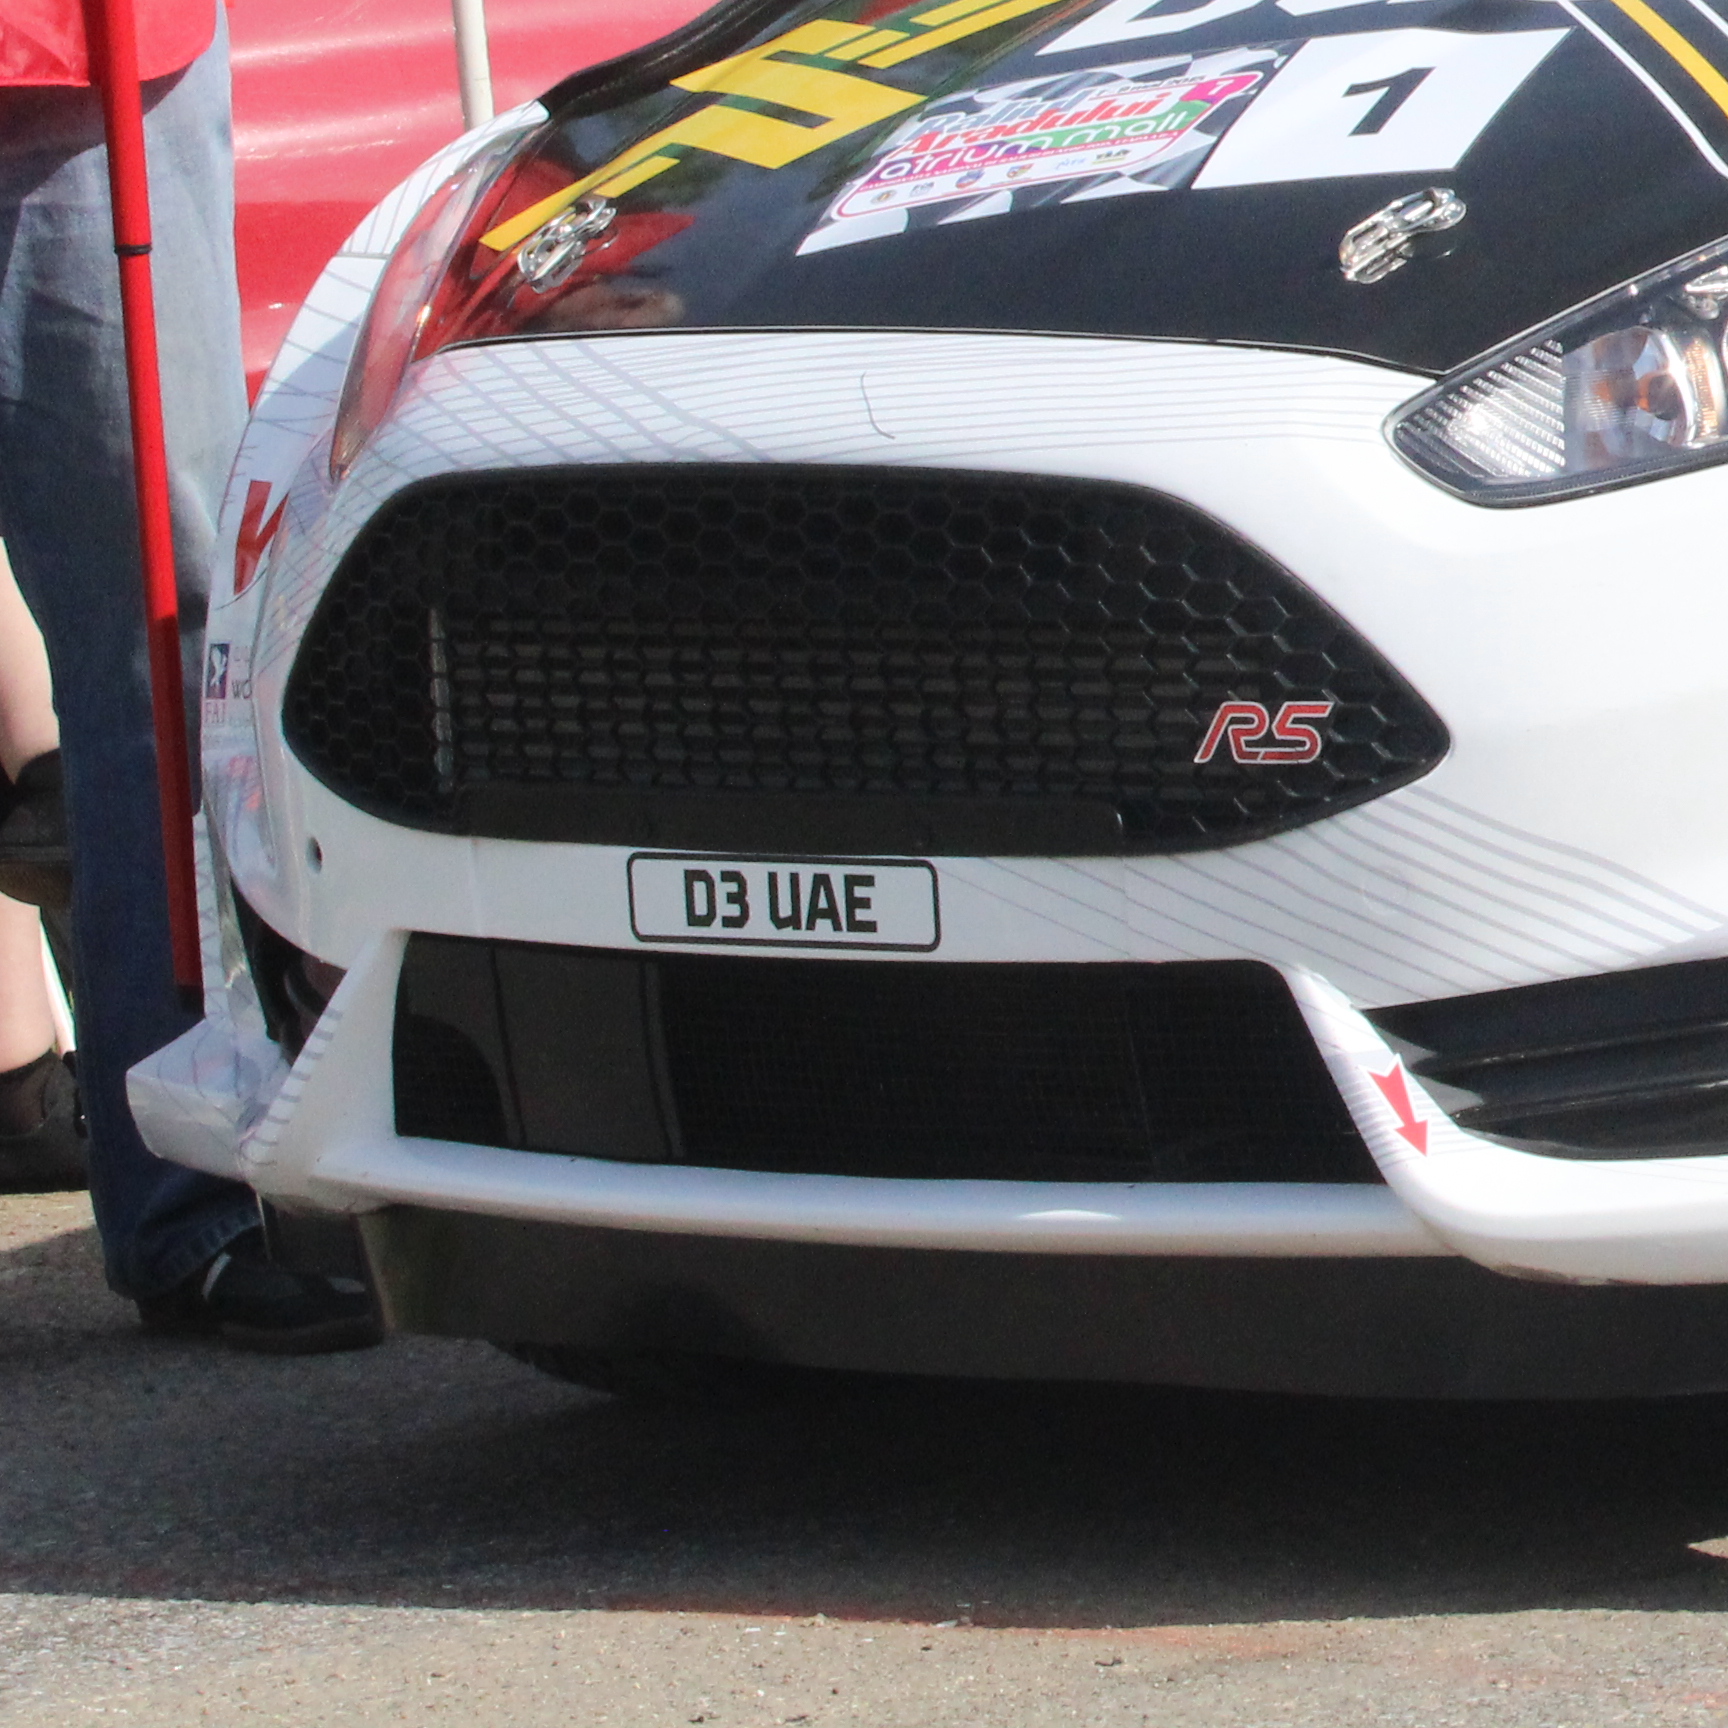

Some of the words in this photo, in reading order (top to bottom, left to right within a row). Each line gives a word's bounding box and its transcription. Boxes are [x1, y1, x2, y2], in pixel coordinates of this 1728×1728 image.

[1342, 65, 1438, 138] 1
[879, 134, 1054, 180] atrium
[1057, 110, 1188, 150] mall
[1195, 699, 1334, 766] RS
[682, 869, 749, 931] D3
[767, 872, 879, 936] UAE
